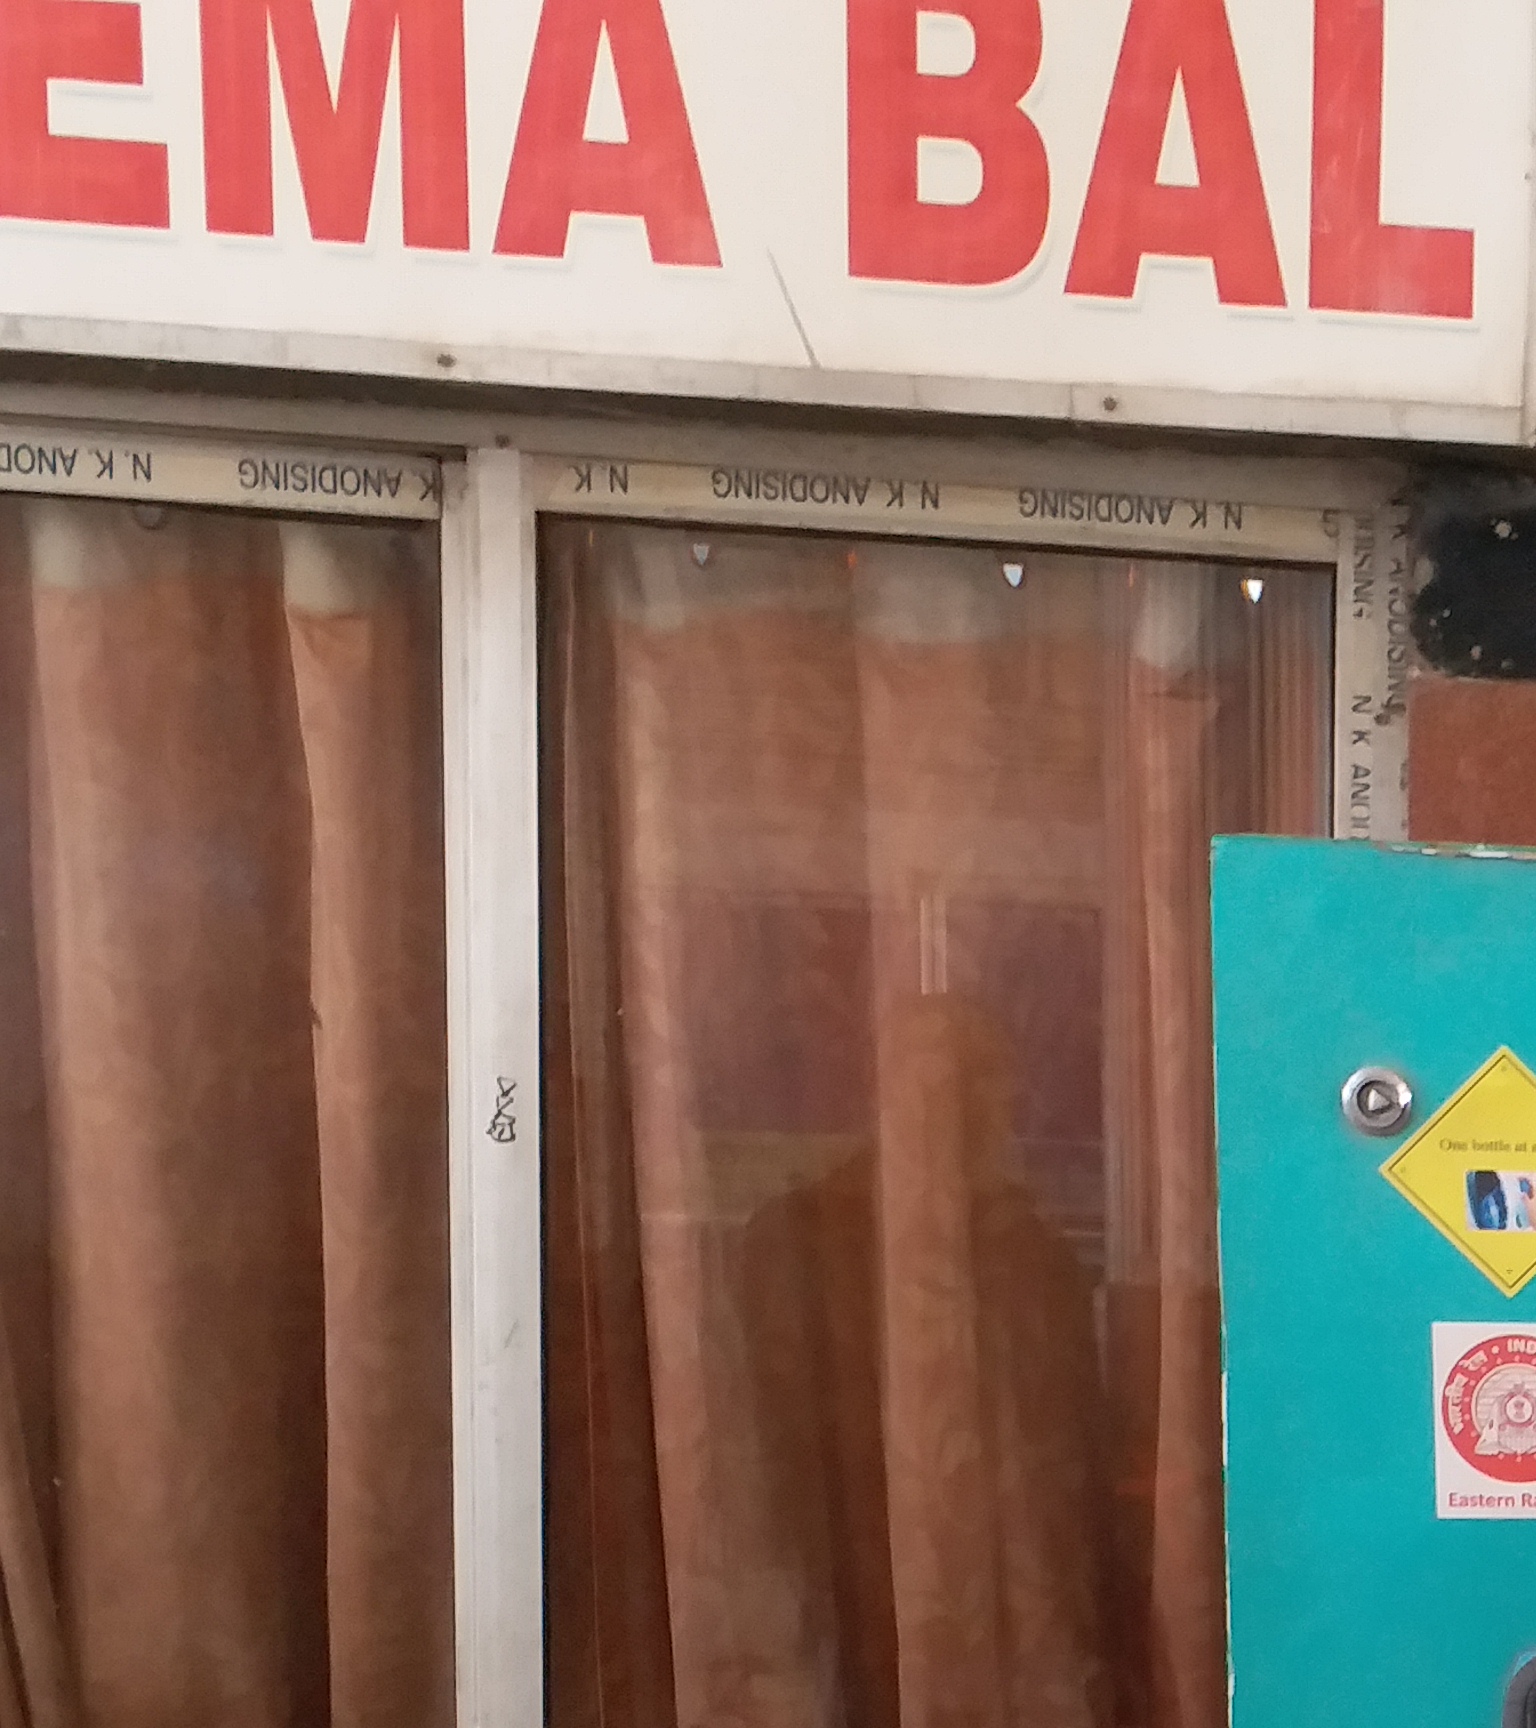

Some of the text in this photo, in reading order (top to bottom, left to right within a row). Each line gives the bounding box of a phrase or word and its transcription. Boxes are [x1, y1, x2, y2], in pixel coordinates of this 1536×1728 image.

[0, 0, 1475, 320] EMA BAL
[238, 457, 402, 499] ANODISING
[711, 467, 871, 506] ANODISING
[1018, 485, 1173, 526] ANODISING
[1448, 1491, 1515, 1508] Eastern
